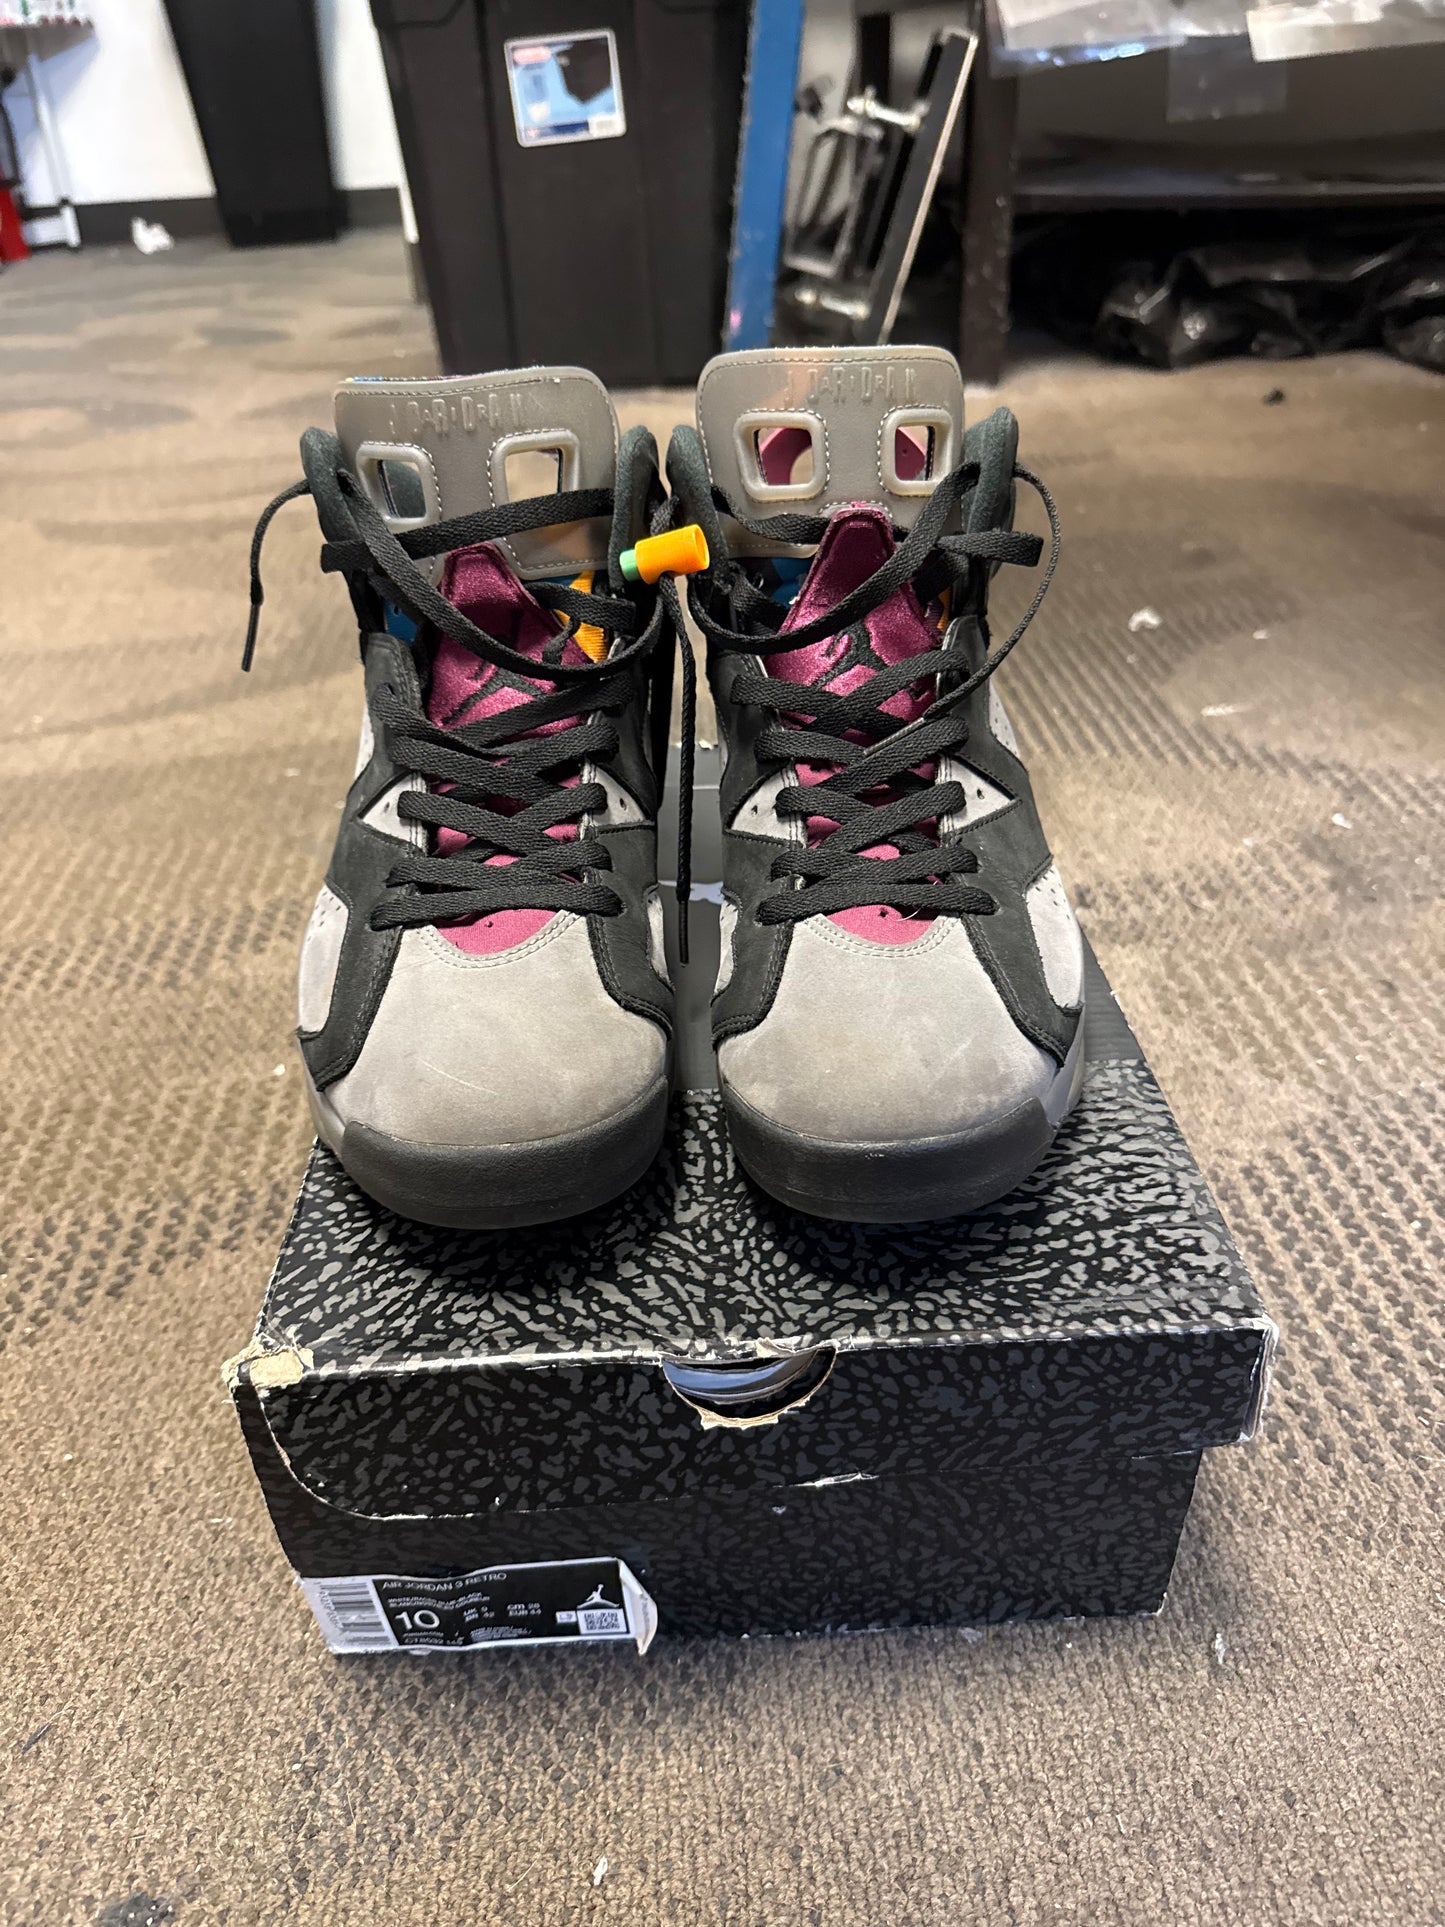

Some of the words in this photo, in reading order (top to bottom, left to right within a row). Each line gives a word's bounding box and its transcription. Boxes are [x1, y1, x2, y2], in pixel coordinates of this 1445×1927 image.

[382, 1581, 403, 1590] AIR
[405, 1581, 453, 1592] JORDAN
[455, 1578, 464, 1588] 3
[465, 1572, 507, 1585] RETRO
[395, 1609, 440, 1631] 10
[463, 1607, 477, 1616] UK
